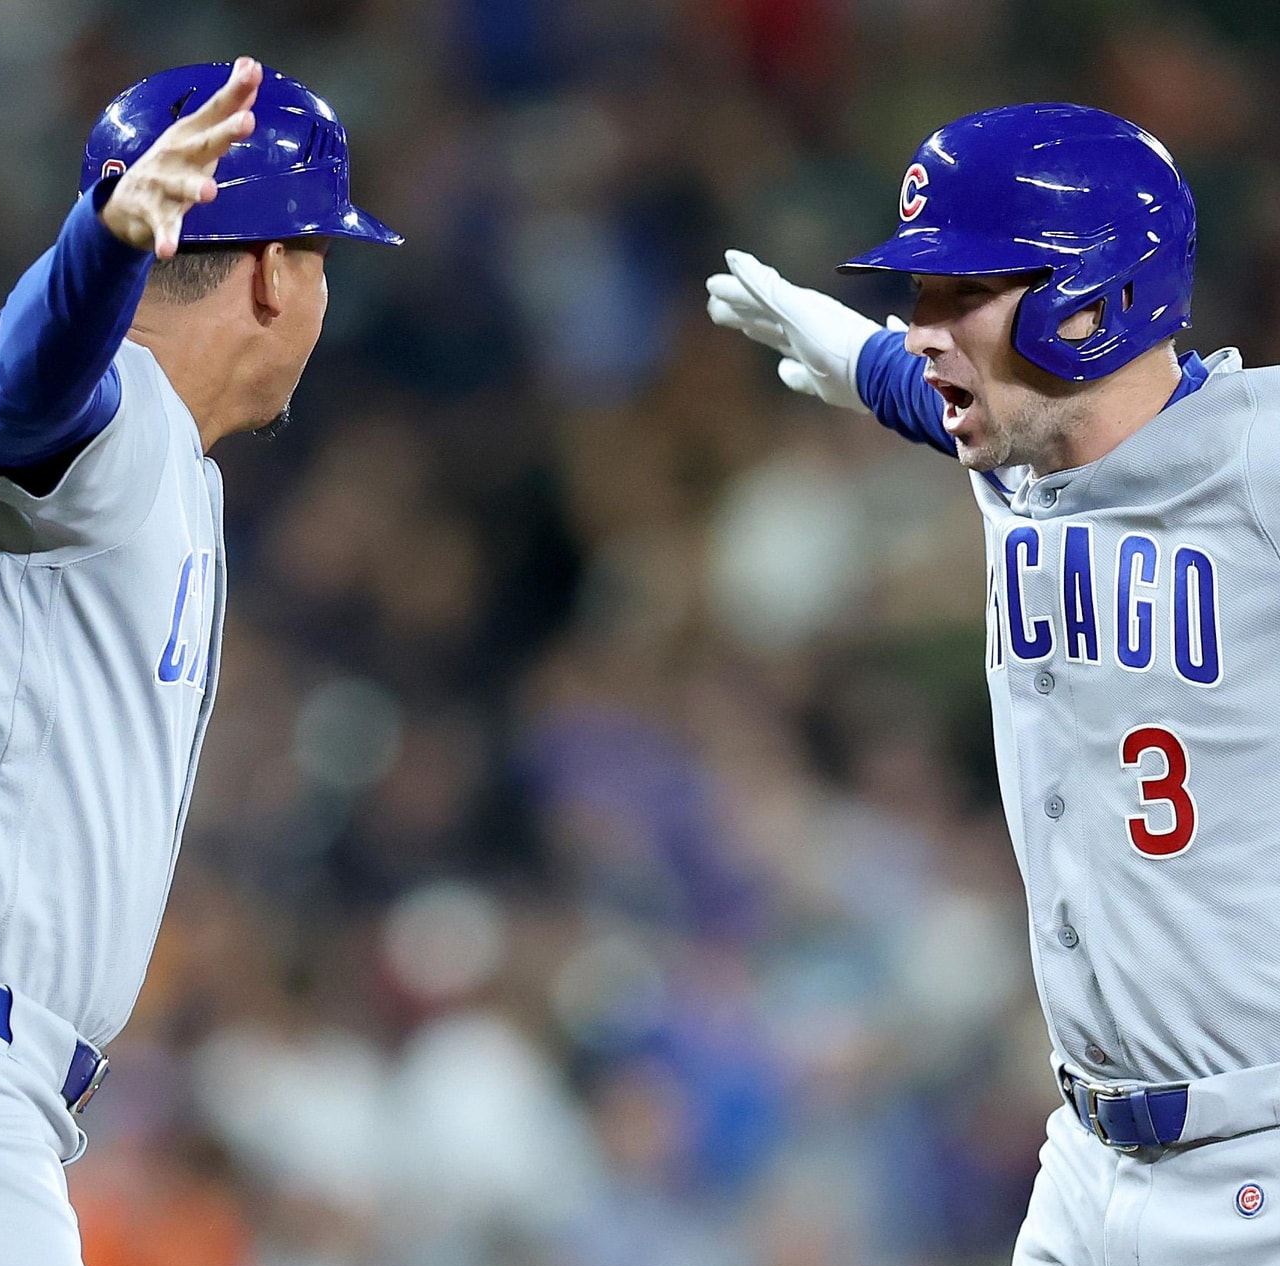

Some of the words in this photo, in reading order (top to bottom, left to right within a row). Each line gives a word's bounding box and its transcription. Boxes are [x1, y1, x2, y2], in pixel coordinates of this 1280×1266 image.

[899, 163, 929, 222] C
[986, 521, 1224, 689] CAGO
[1119, 722, 1199, 861] 3
